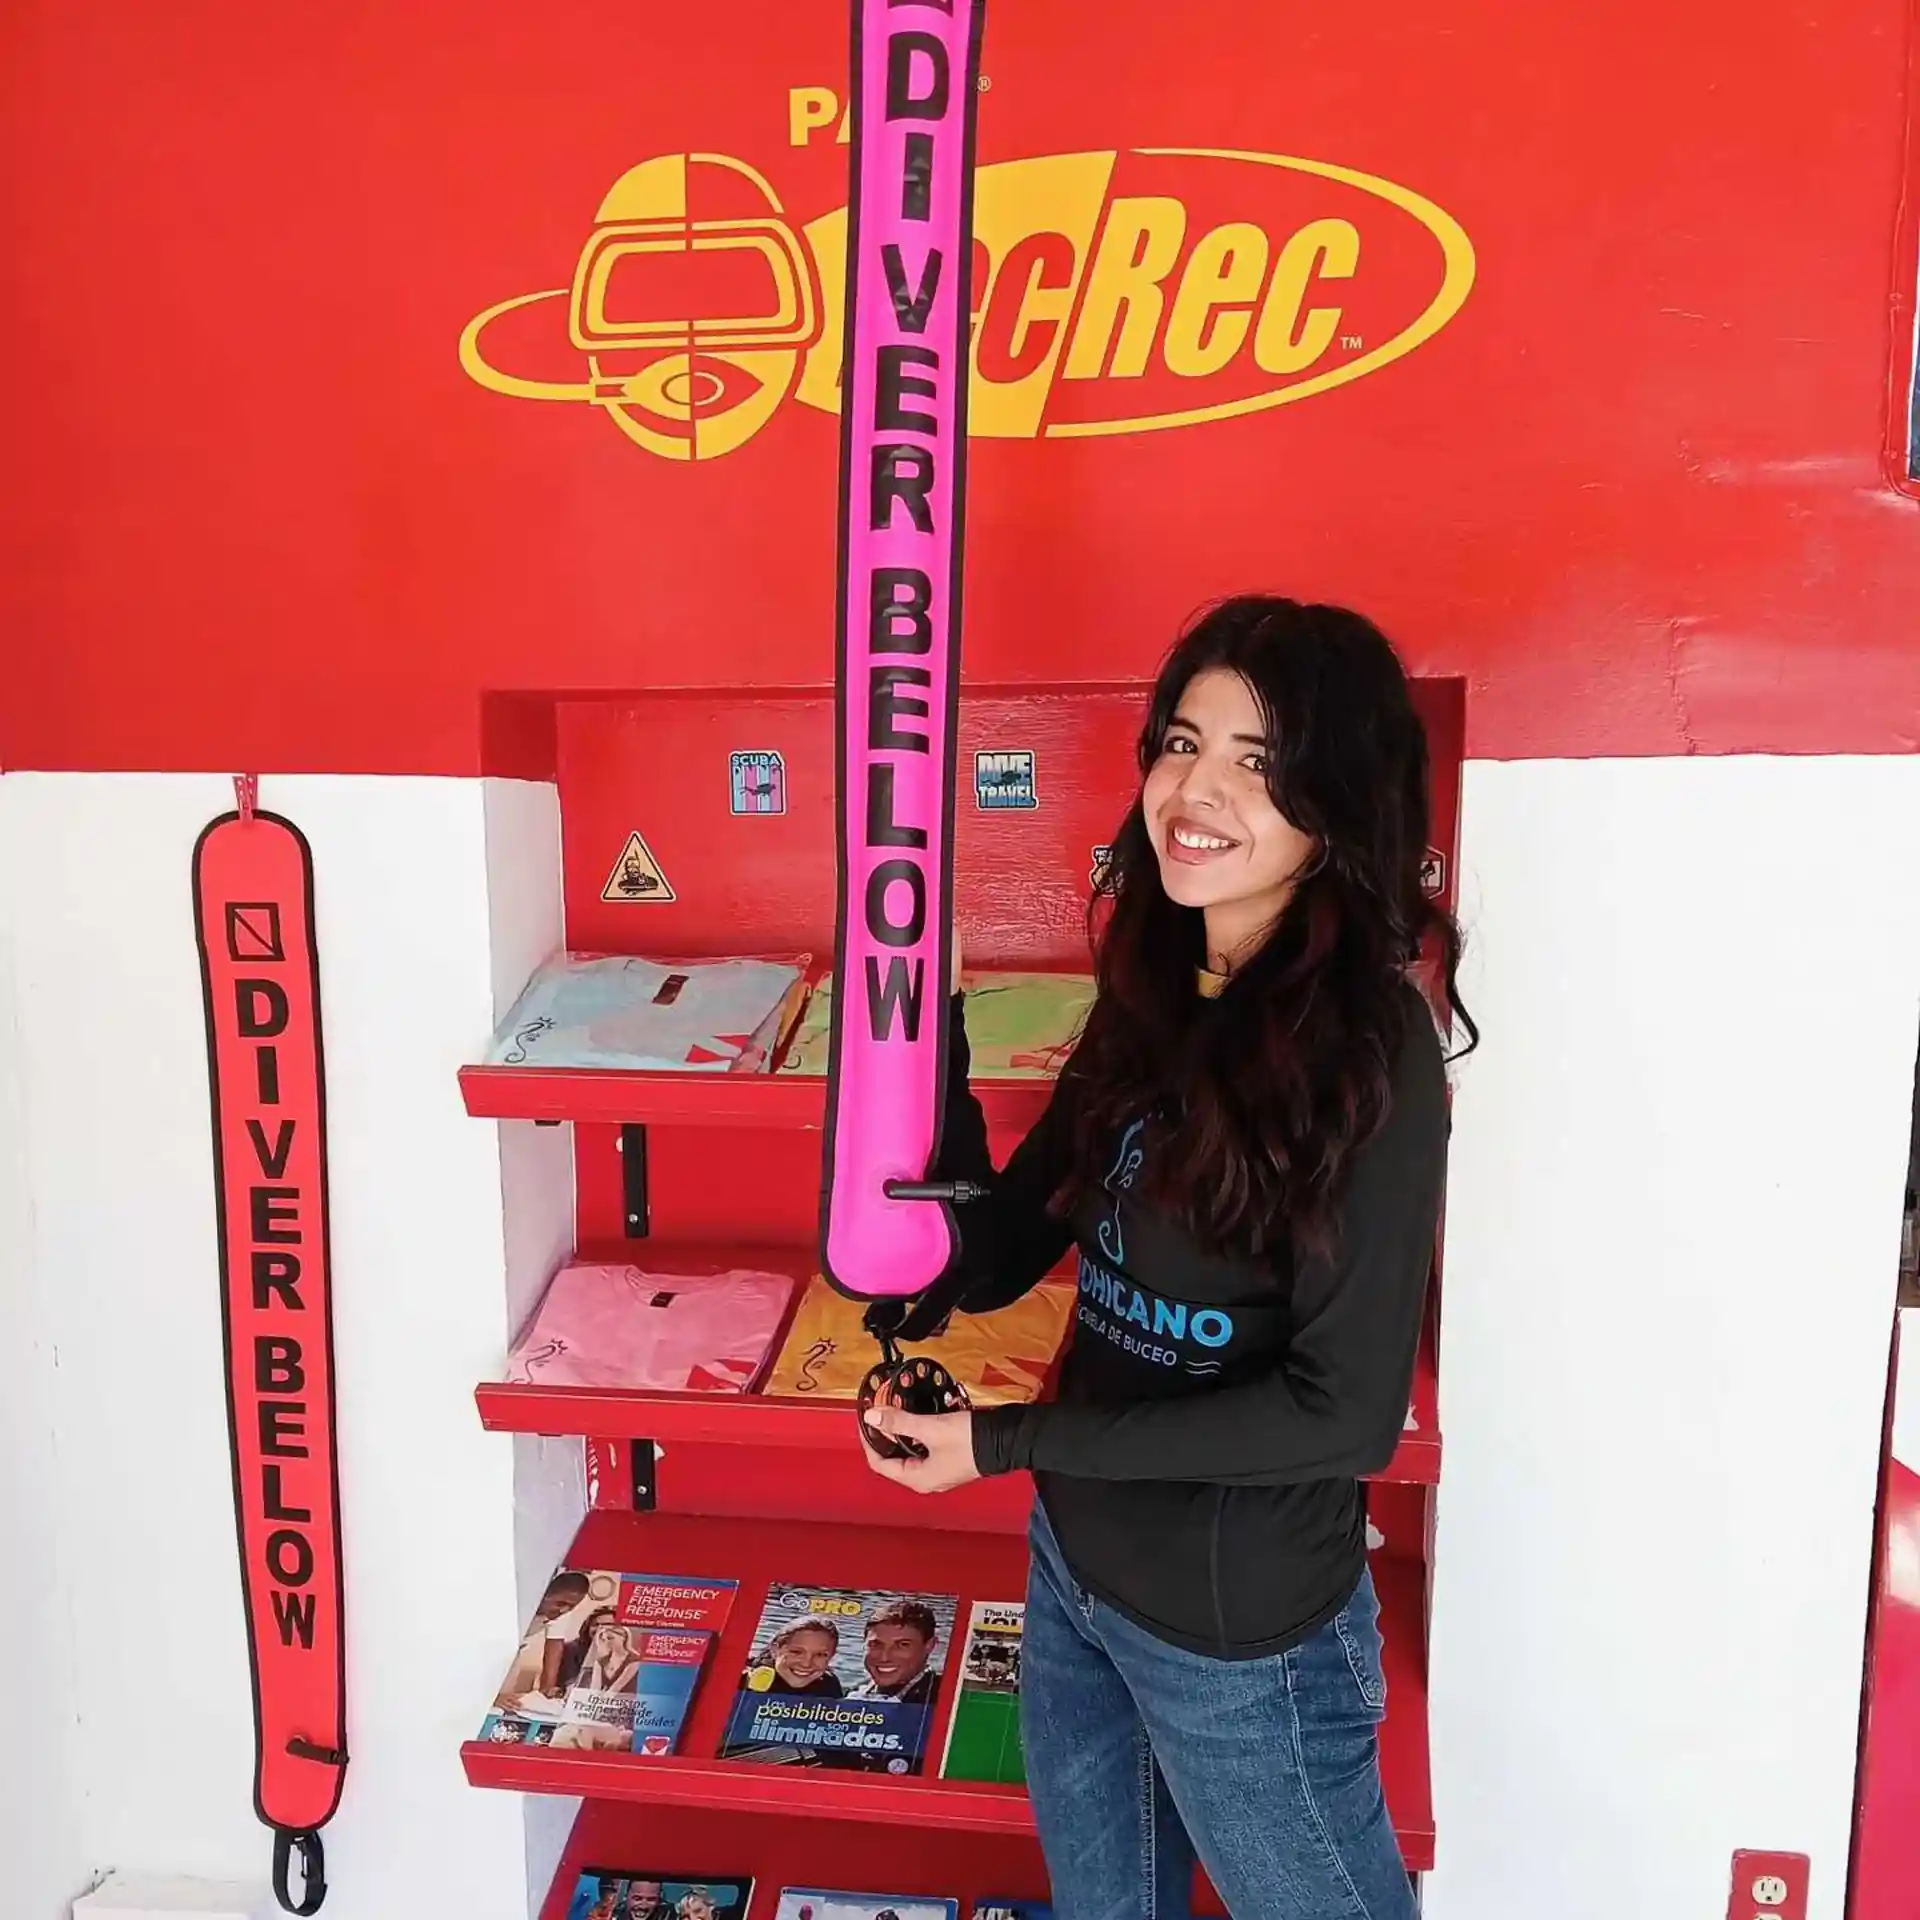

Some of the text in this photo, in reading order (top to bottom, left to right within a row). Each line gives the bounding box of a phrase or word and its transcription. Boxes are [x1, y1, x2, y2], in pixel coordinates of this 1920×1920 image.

[865, 31, 950, 1042] DIVER BELOW
[732, 755, 780, 766] SCUBA
[1078, 1254, 1233, 1348] OHICANO
[234, 978, 315, 1649] DIVER BELOW
[1107, 1326, 1121, 1345] DE
[1123, 1335, 1177, 1366] BUCEO
[629, 1596, 671, 1607] FIRST
[634, 1585, 719, 1600] EMERGENCY
[626, 1605, 704, 1620] RESPONSE
[984, 1609, 1002, 1617] The
[636, 1716, 676, 1727] Guides
[756, 1700, 884, 1725] posibilidades
[750, 1718, 903, 1750] ilimitadas.
